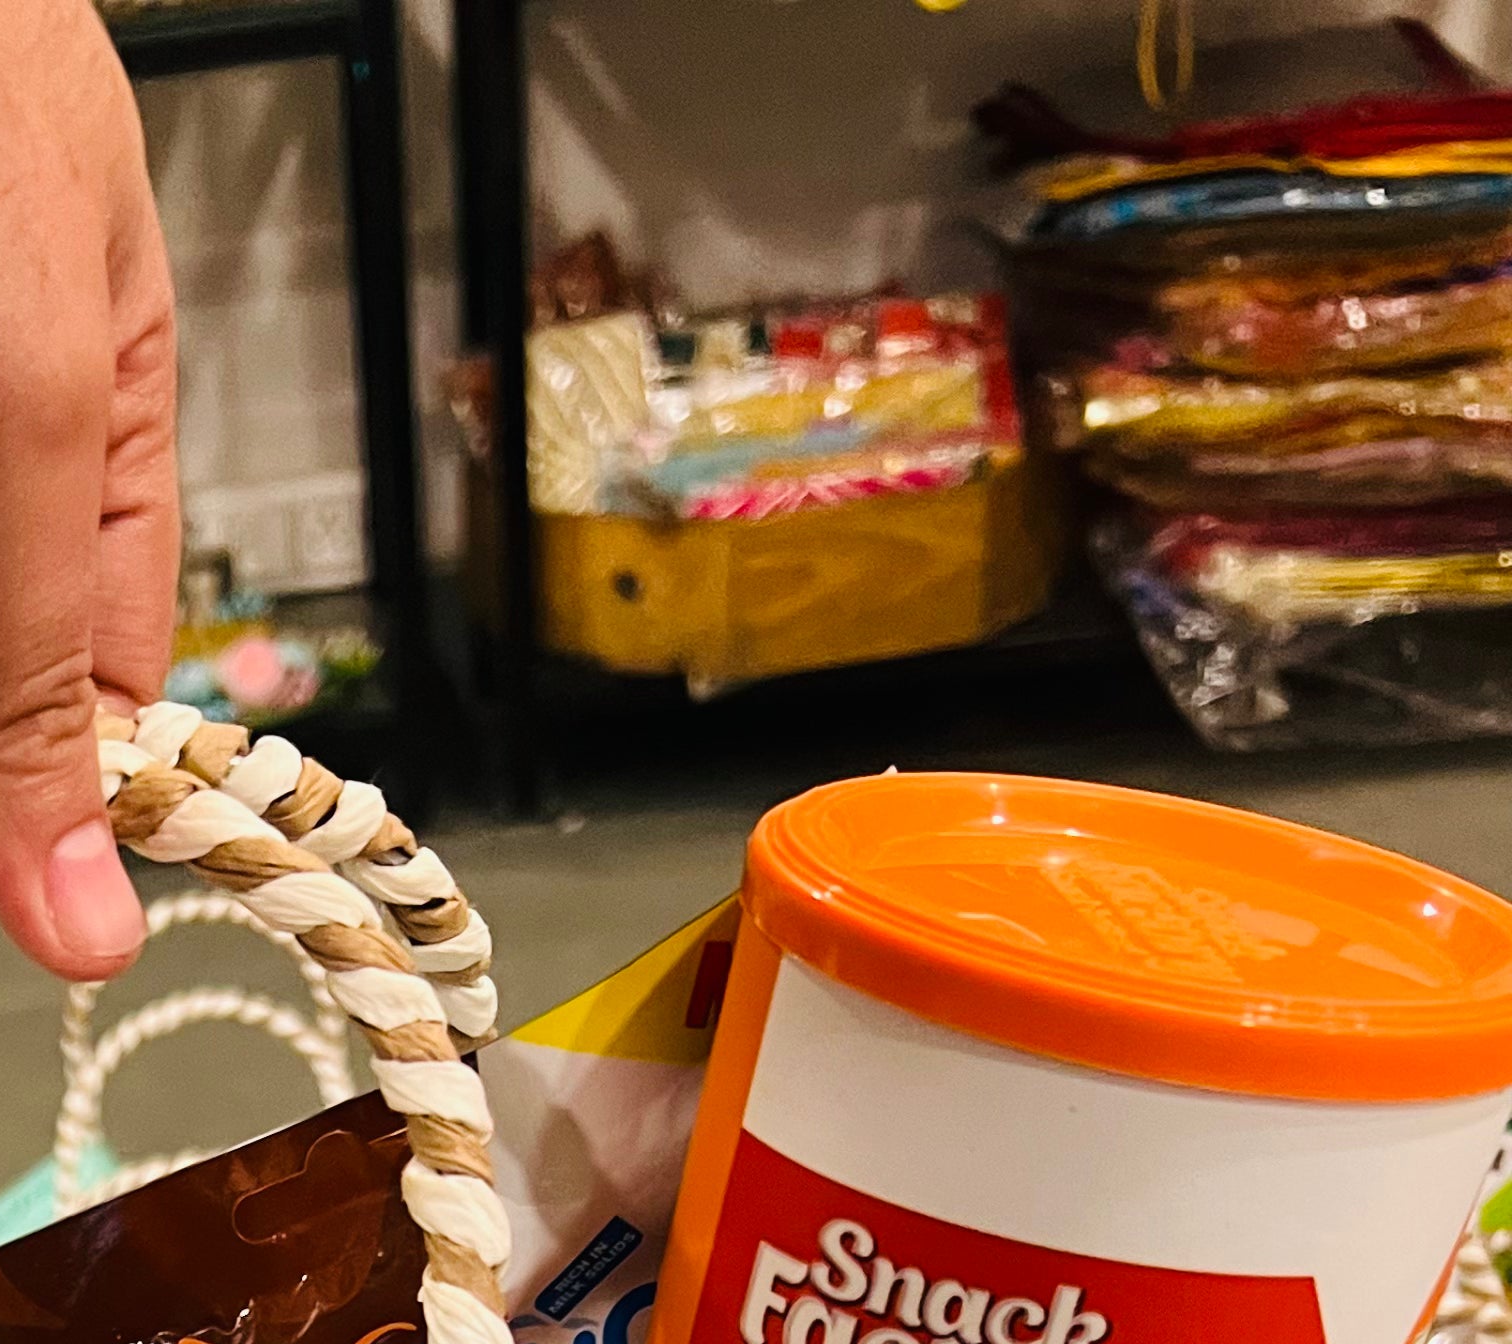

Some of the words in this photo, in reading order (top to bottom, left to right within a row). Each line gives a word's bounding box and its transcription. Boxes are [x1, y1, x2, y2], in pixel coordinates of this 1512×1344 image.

[548, 1281, 586, 1314] MILK
[585, 1231, 636, 1278] SOLIDS
[554, 1260, 590, 1293] RICH
[589, 1241, 608, 1259] IN
